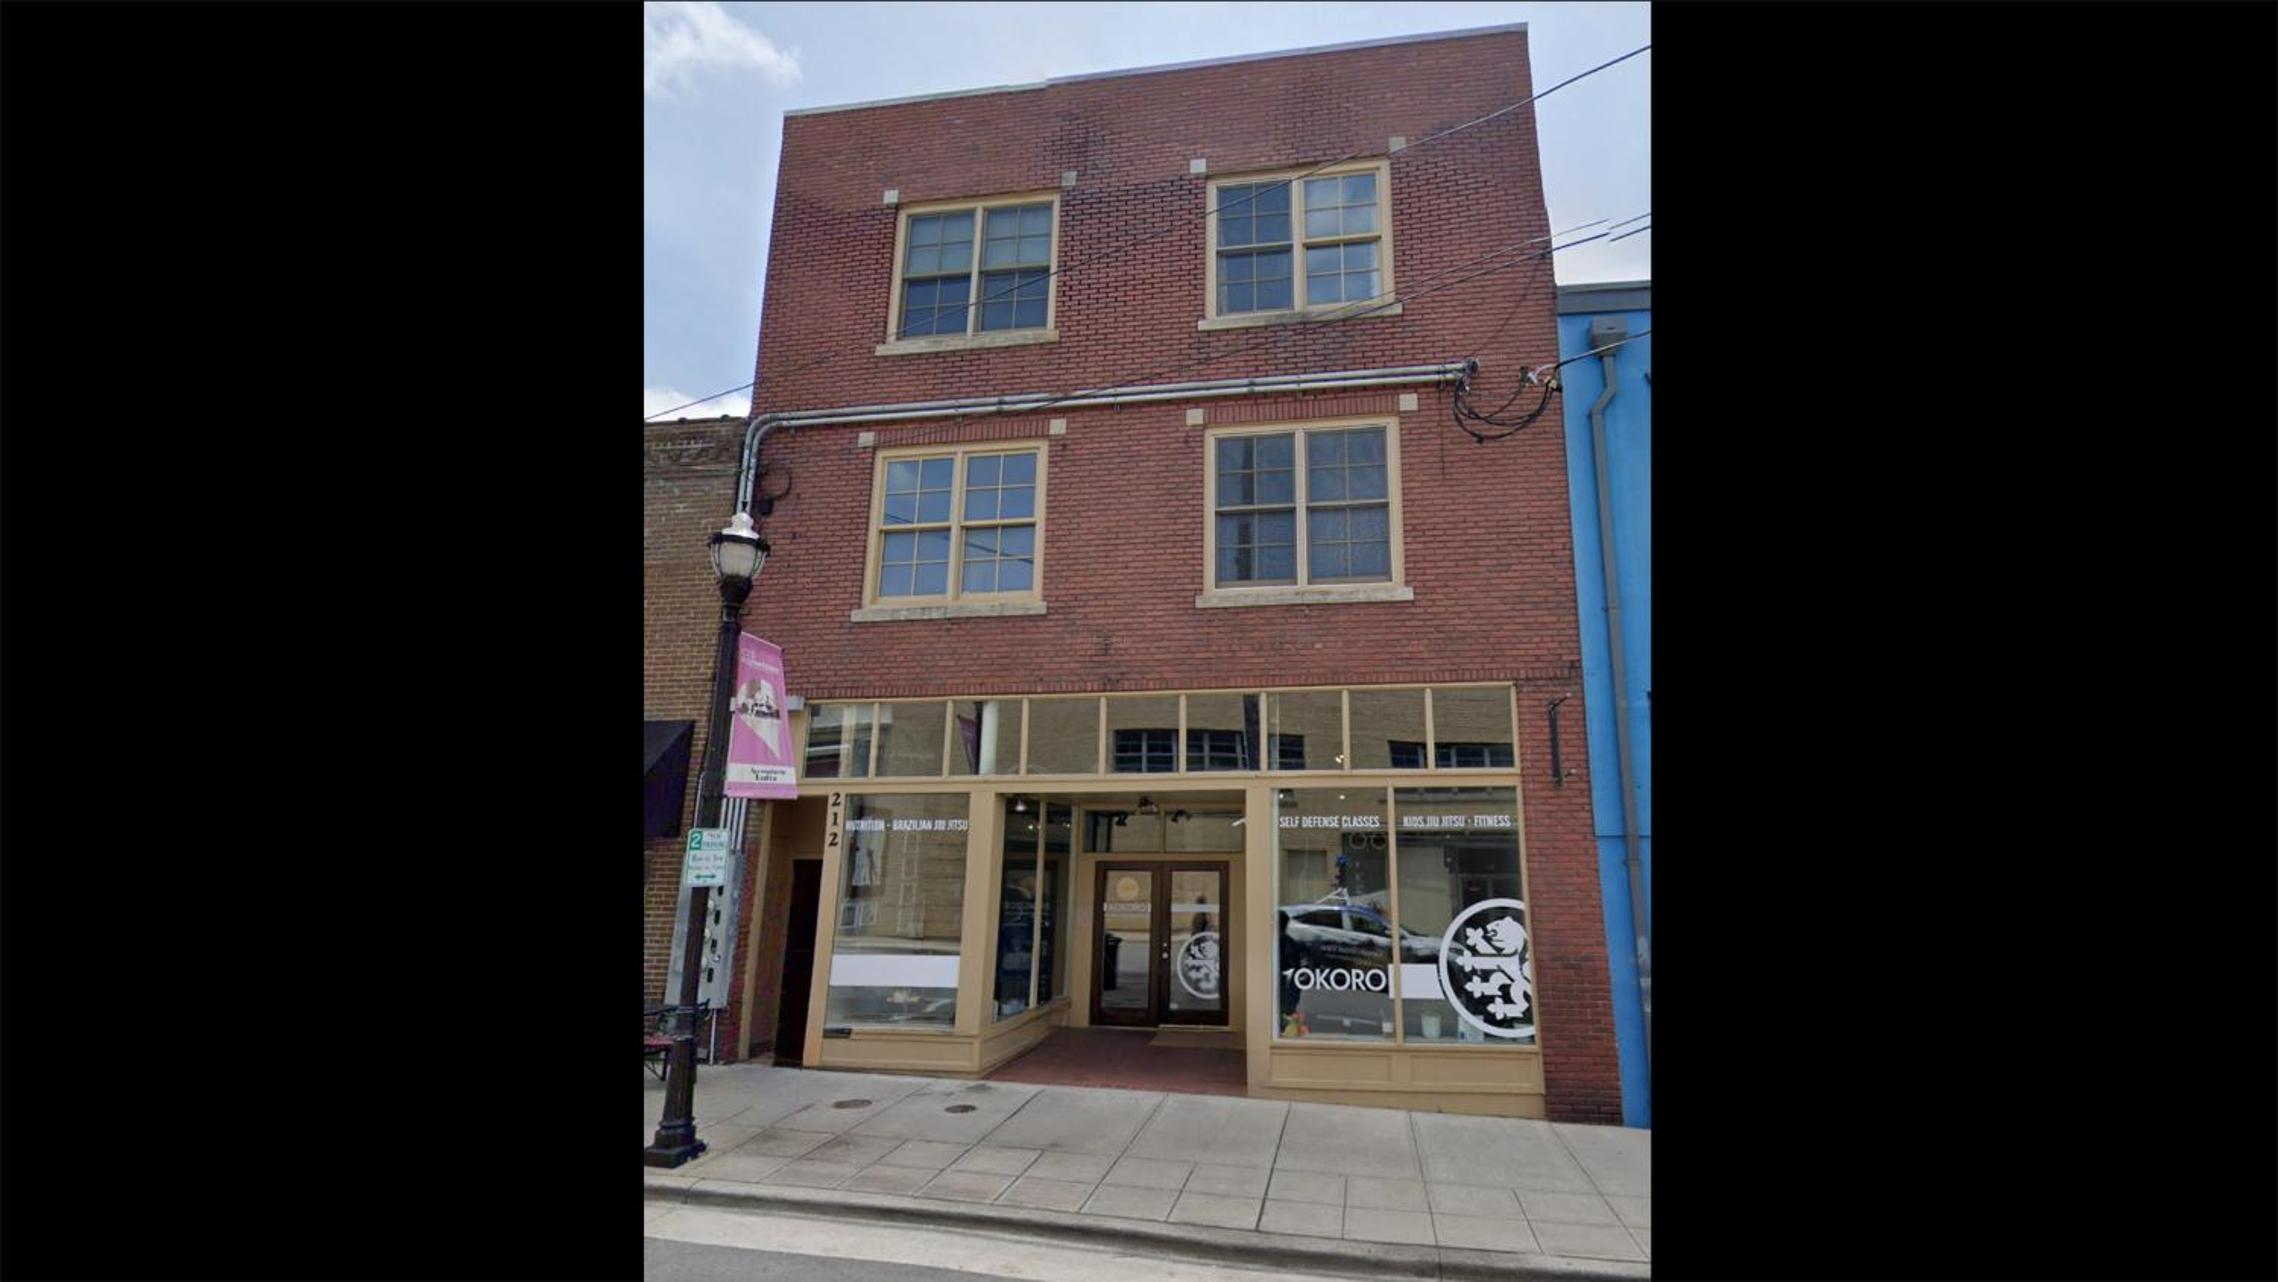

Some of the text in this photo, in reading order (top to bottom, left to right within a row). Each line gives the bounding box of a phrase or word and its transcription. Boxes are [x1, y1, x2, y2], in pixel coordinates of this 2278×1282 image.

[892, 819, 932, 832] BRAZILIAN
[1280, 815, 1380, 828] SELF DEFENSE CLASSES
[1403, 815, 1424, 828] KIDS
[1474, 815, 1511, 828] FITNESS
[691, 832, 702, 848] 2
